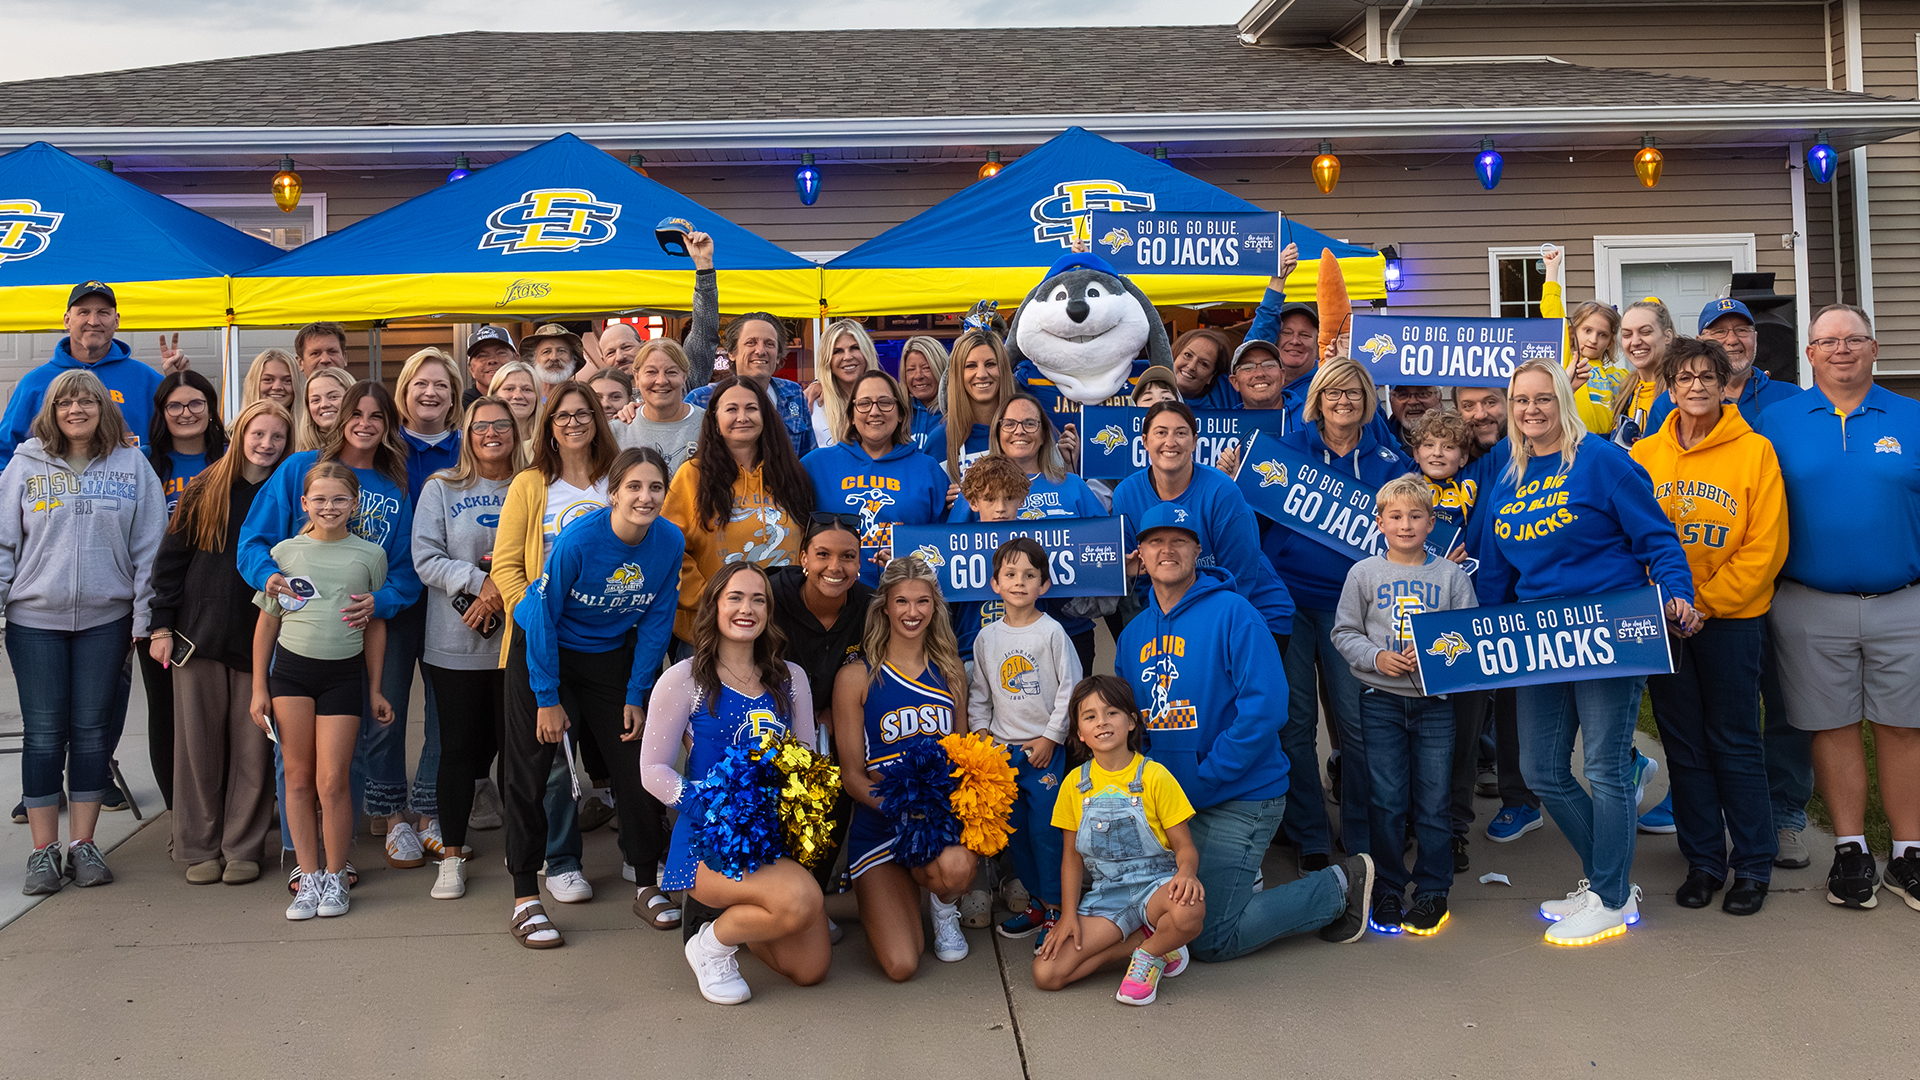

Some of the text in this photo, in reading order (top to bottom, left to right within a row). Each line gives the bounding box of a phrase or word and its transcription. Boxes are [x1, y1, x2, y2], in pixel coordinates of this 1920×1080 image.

[1137, 220, 1239, 235] GO BIG. GO BLUE.
[1137, 237, 1166, 266] GO
[1244, 240, 1274, 249] STATE
[1402, 326, 1517, 344] GO BIG. GO BLUE.
[1400, 344, 1433, 377] GO
[1522, 349, 1556, 359] STATE
[1207, 417, 1241, 434] BLUE.
[1131, 436, 1150, 467] G
[26, 471, 80, 503] SDSU
[83, 480, 136, 500] JACKS
[163, 476, 194, 496] CL
[841, 474, 901, 491] CLUB
[1297, 464, 1318, 485] GO
[1319, 474, 1344, 500] BIG.
[1350, 489, 1370, 510] GO
[1516, 475, 1568, 499] GO BIG
[1500, 491, 1569, 515] GO BLUE
[1656, 480, 1738, 517] CKRABBITS
[1283, 483, 1389, 556] GO JACK
[1494, 507, 1579, 541] GO JACKS.
[950, 533, 969, 551] GO
[1035, 529, 1074, 547] BLUE.
[1678, 522, 1730, 549] SU
[1081, 552, 1117, 563] STATE
[950, 553, 987, 590] GO
[571, 588, 657, 607] HALL OF FAM
[1377, 580, 1441, 610] SDSU
[1472, 604, 1608, 636] GO BIG. GO BLUE.
[1618, 625, 1658, 639] STATE
[1140, 635, 1186, 663] CLUB
[1477, 637, 1519, 676] GO
[1002, 658, 1027, 686] SDSU
[1160, 674, 1171, 689] 3
[880, 704, 954, 744] SDSU
